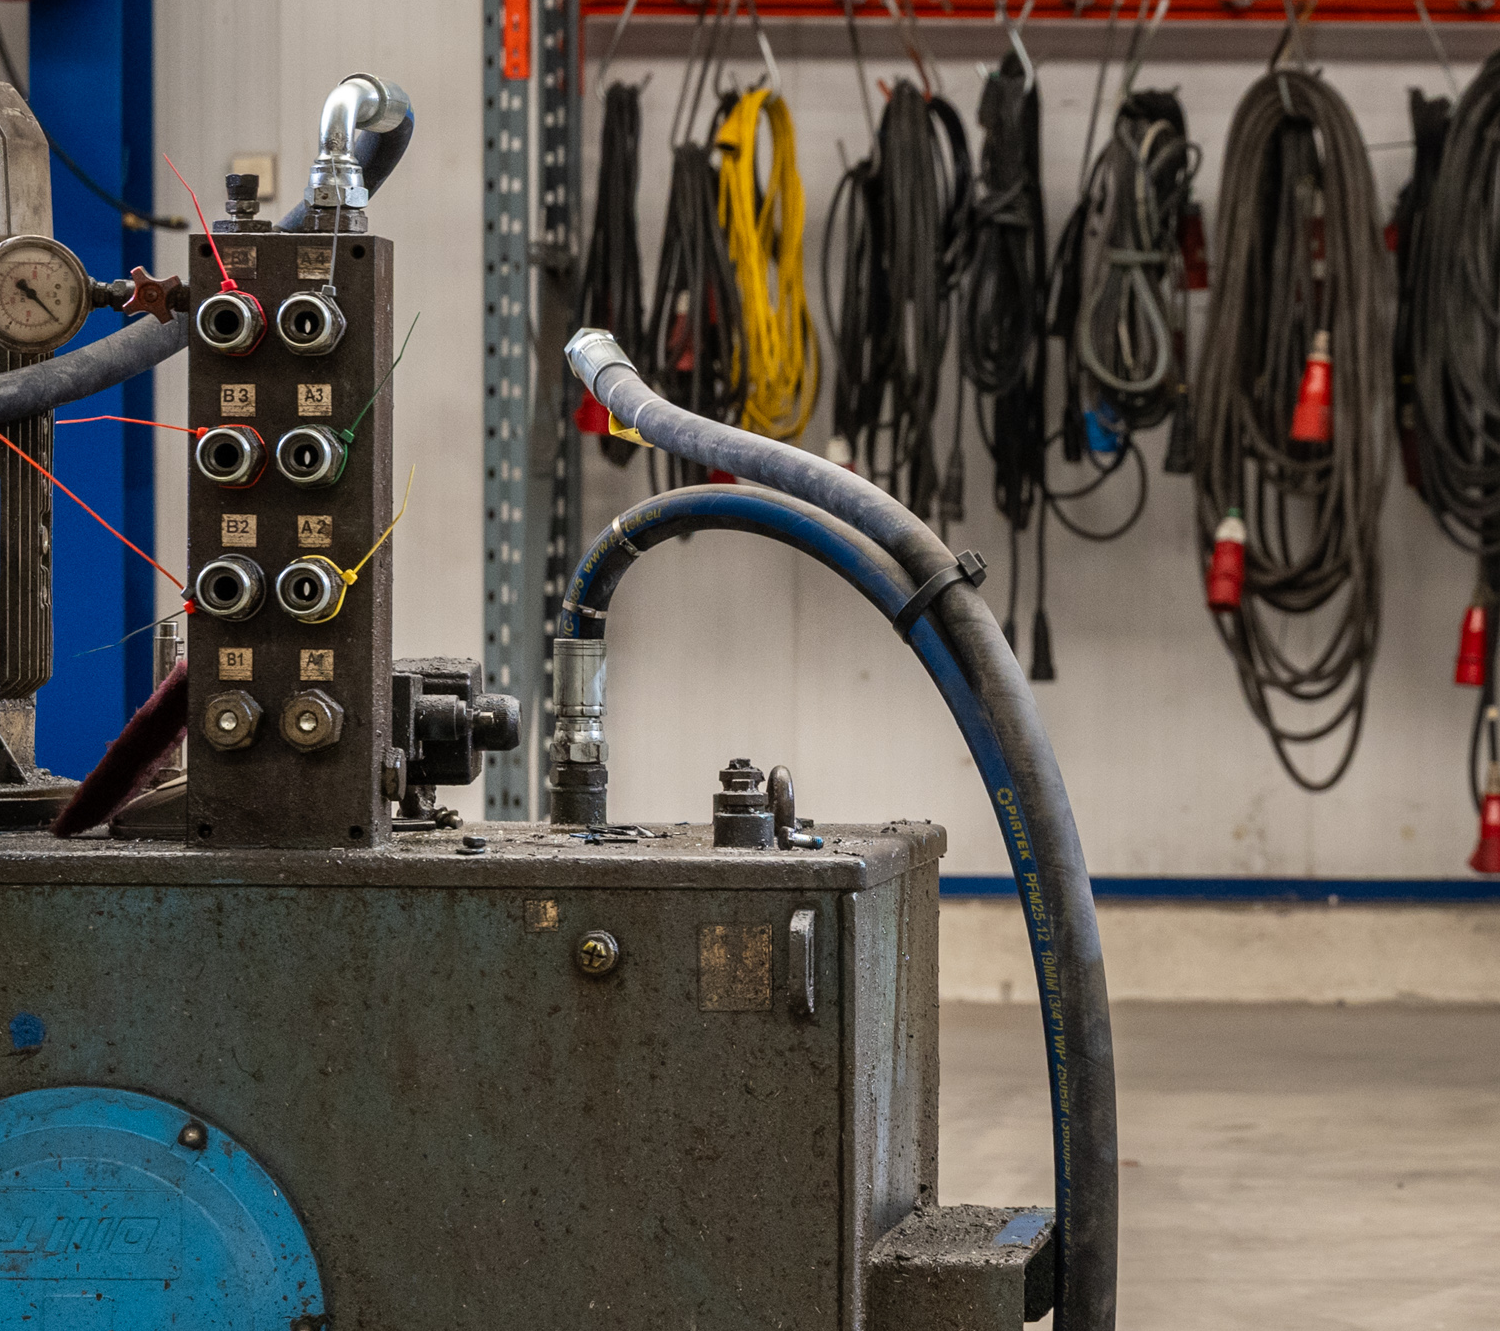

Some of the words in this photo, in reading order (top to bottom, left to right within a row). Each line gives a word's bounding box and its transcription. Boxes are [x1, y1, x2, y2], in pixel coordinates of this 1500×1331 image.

[305, 388, 324, 403] A3
[226, 520, 250, 534] B2
[583, 508, 662, 574] www.ptek.eu
[227, 652, 244, 666] B1
[1006, 805, 1032, 860] PIRTEK
[1024, 872, 1050, 941] PFM25-12
[1040, 950, 1060, 991] 19MM
